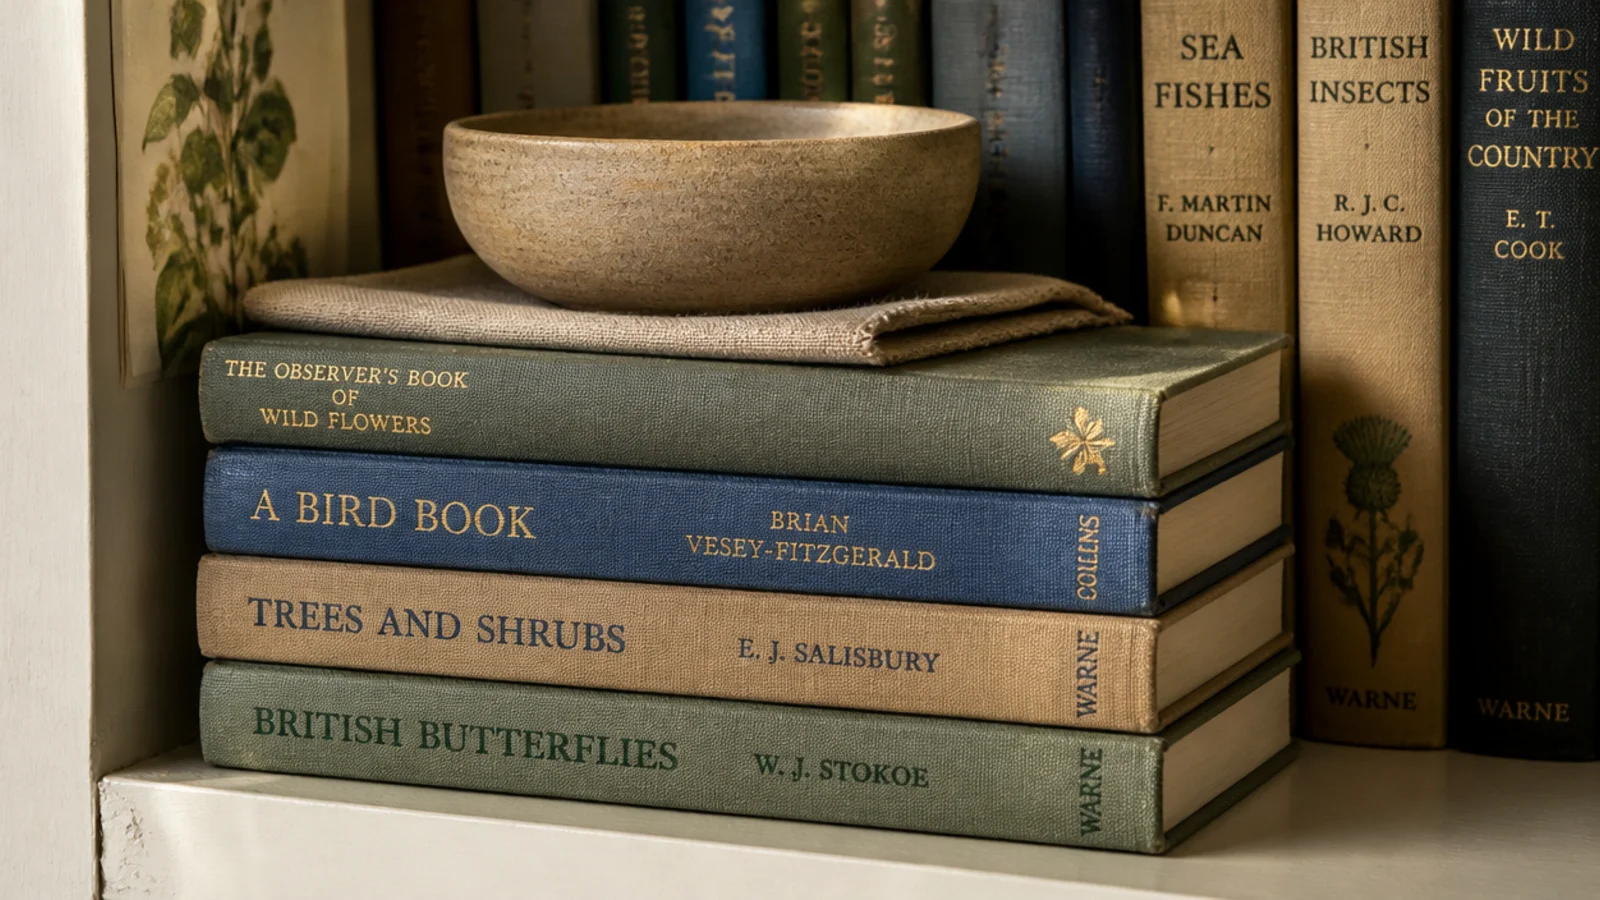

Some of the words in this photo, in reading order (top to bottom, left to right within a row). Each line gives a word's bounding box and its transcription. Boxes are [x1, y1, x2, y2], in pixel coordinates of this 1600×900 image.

[1180, 34, 1245, 61] SEA
[1310, 36, 1430, 60] BRITISH
[1492, 28, 1576, 52] WILD
[1310, 80, 1431, 104] INSECTS
[1479, 69, 1589, 93] FRUITS
[1154, 81, 1272, 109] FISHES
[1485, 109, 1516, 129] OF
[1528, 109, 1580, 129] THE
[1467, 145, 1599, 169] COUNTRY
[1157, 195, 1174, 212] F.
[1181, 194, 1272, 213] MARTIN
[1333, 195, 1355, 212] R.
[1361, 195, 1375, 216] J.
[1383, 195, 1406, 212] C.
[1506, 210, 1526, 229] E.
[1535, 210, 1555, 230] T.
[1166, 224, 1263, 243] DUNCAN
[1317, 223, 1422, 243] HOWARD
[1494, 240, 1565, 260] COOK
[225, 360, 268, 378] THE
[274, 362, 399, 385] OBSERVER'S
[407, 371, 469, 389] BOOK
[331, 389, 359, 406] OF
[260, 408, 319, 428] WILD
[328, 412, 432, 435] FLOWERS
[250, 489, 281, 522] A
[296, 491, 397, 529] BIRD
[415, 499, 537, 540] BOOK
[770, 510, 850, 535] BRIAN
[686, 535, 937, 572] VESEY-FITZGERALD
[248, 596, 364, 635] TREES
[378, 607, 462, 640] AND
[477, 615, 626, 654] SHRUBS
[738, 638, 761, 661] E.
[768, 640, 785, 665] J.
[794, 643, 941, 673] SALISBURY
[1076, 630, 1099, 718] WARNE
[1326, 687, 1418, 712] WARNE
[1478, 698, 1570, 722] WARNE
[253, 706, 402, 747] BRITISH
[419, 720, 679, 771] BUTTERFLIES
[753, 753, 785, 777] W.
[791, 757, 810, 782] J.
[818, 760, 930, 788] STOKOE
[1079, 746, 1103, 837] WARNE
